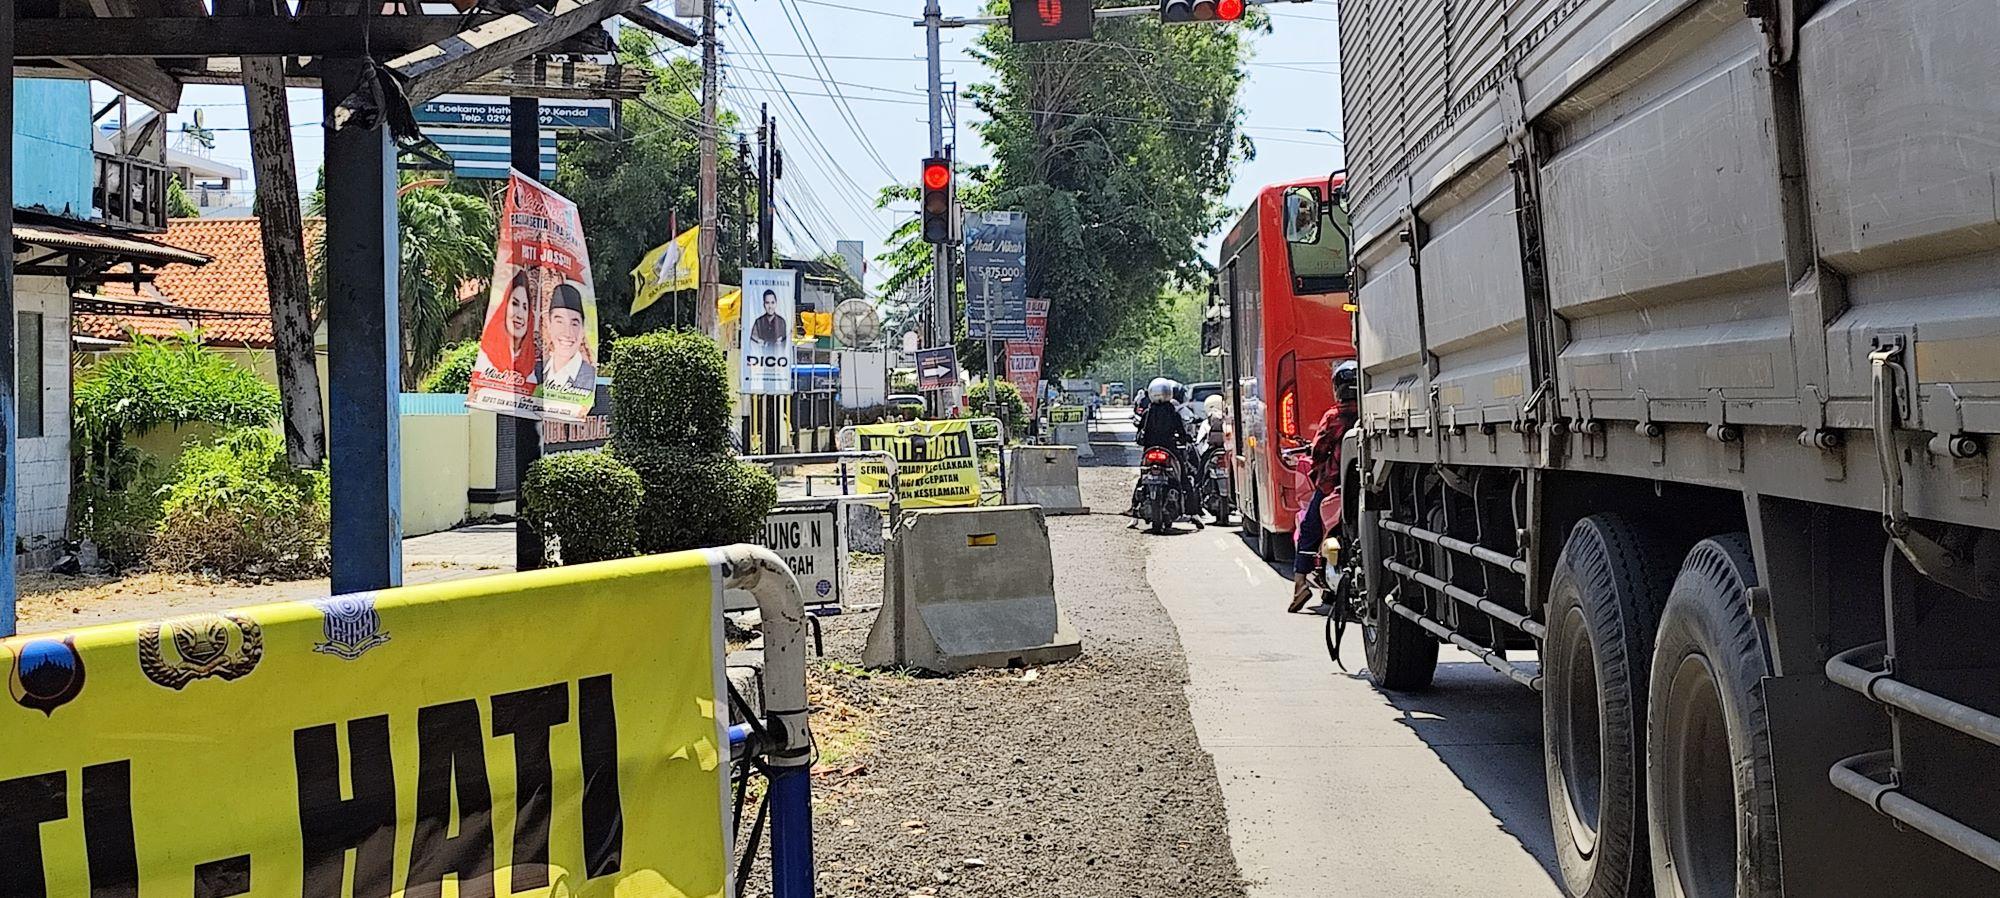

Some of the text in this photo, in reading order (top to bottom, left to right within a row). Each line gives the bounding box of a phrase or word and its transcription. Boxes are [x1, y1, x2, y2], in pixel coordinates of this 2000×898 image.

[553, 108, 589, 117] Kendal
[461, 114, 485, 123] Telp.
[898, 464, 924, 475] ERJADI
[913, 485, 970, 499] KESELAMATAN
[293, 673, 624, 898] HATI
